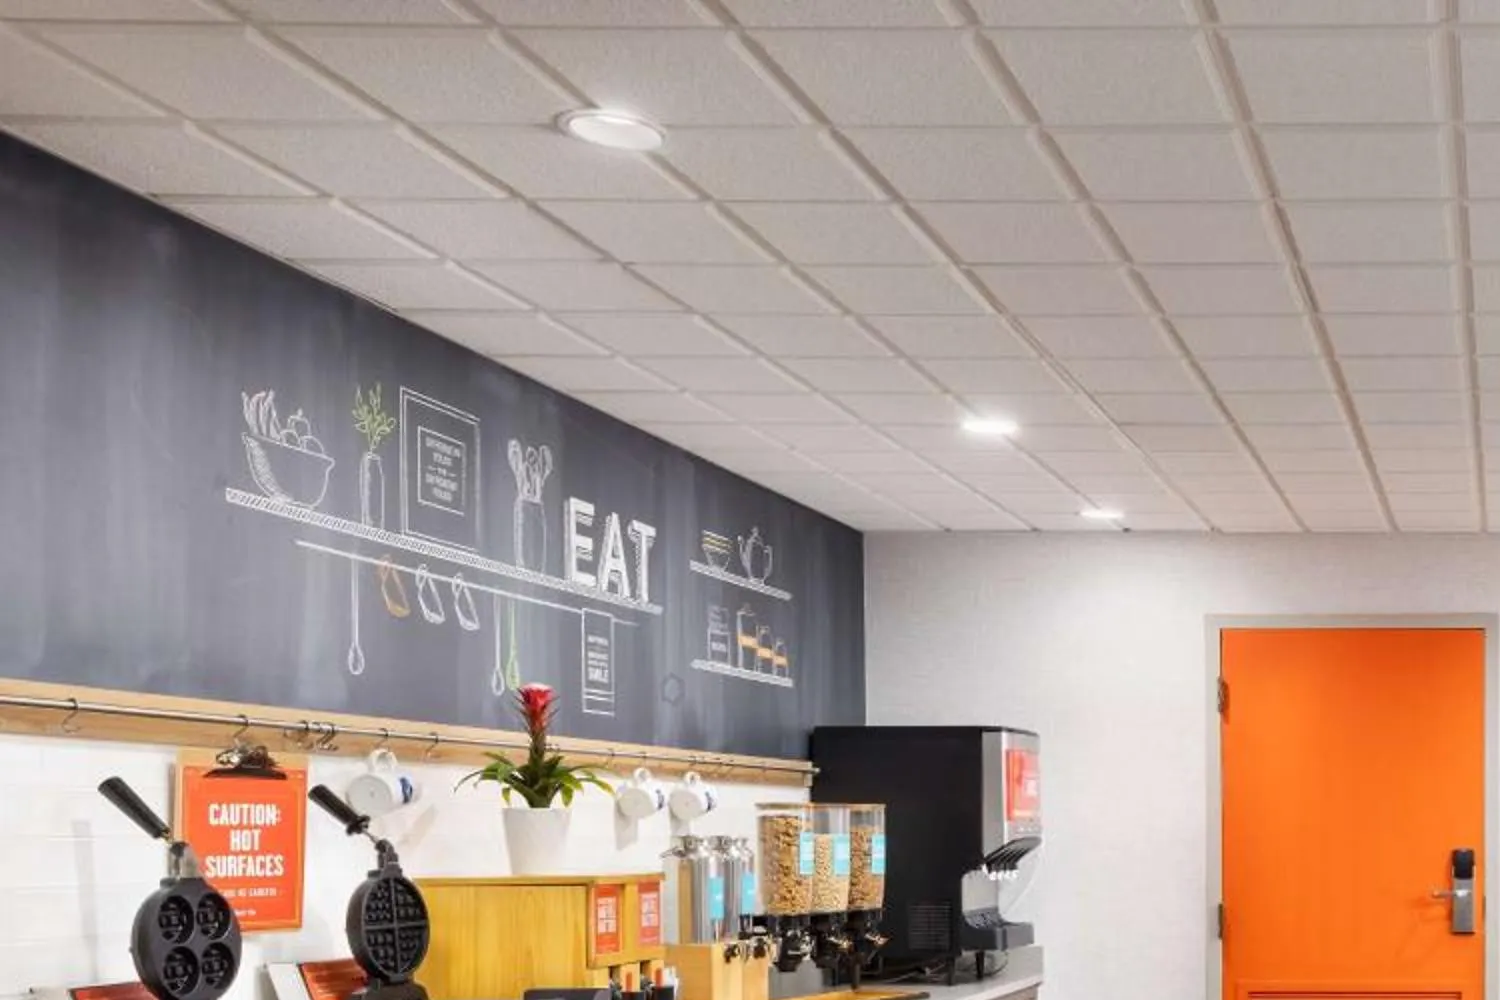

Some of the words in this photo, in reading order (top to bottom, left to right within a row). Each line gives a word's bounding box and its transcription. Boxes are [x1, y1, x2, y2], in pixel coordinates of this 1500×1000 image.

[564, 496, 656, 602] EAT
[208, 803, 281, 826] CAUTION:
[229, 828, 262, 851] HOT
[205, 854, 285, 878] SURFACES
